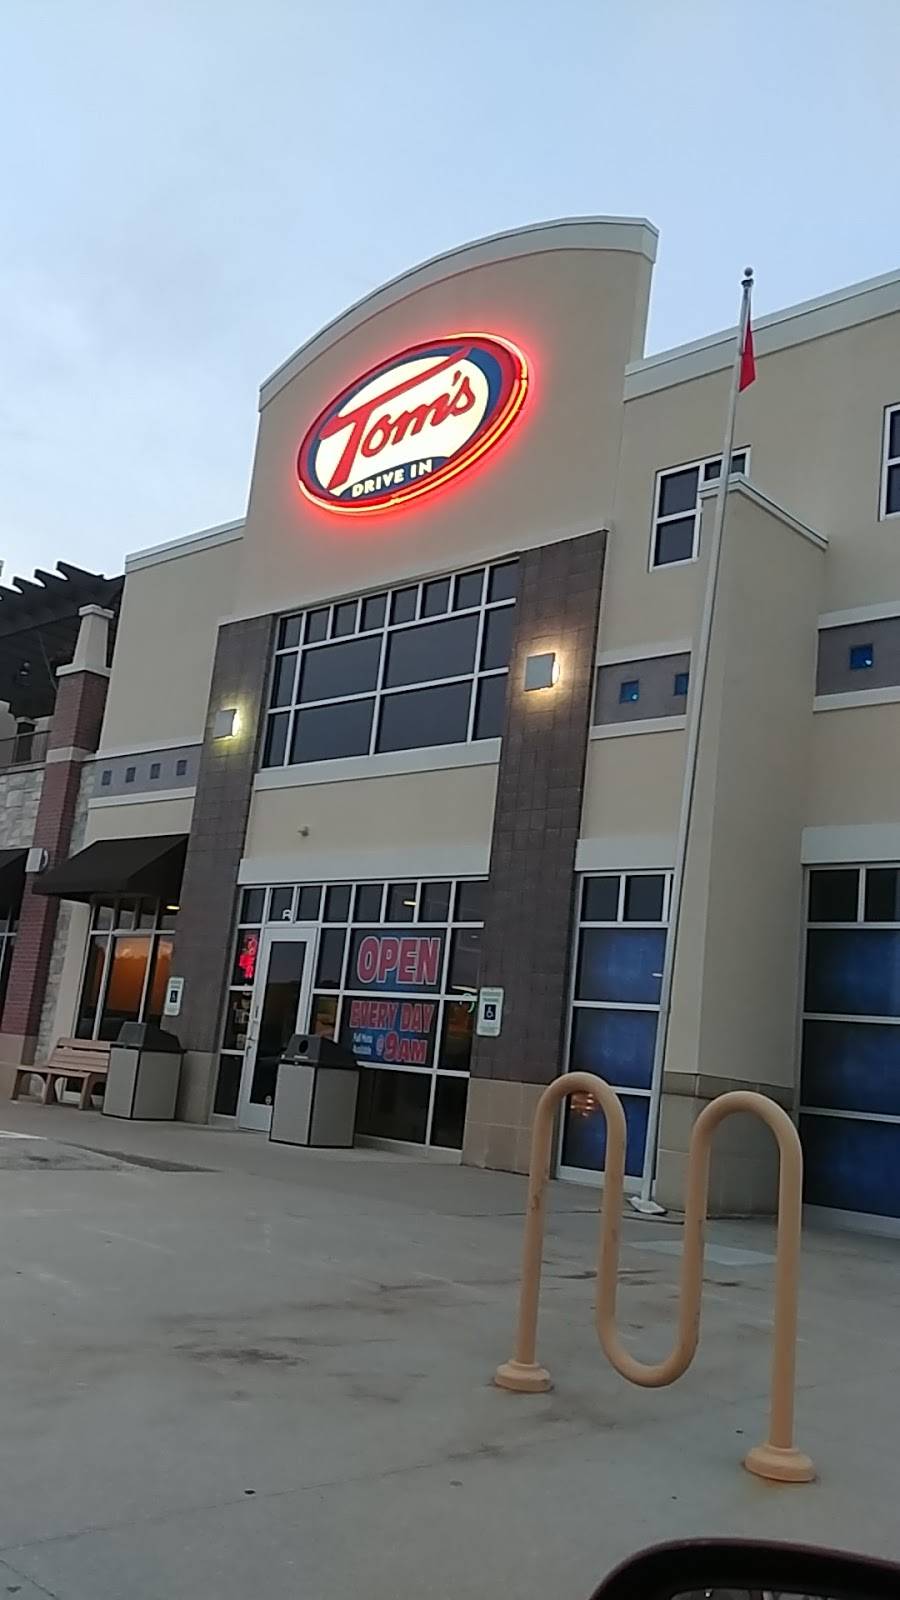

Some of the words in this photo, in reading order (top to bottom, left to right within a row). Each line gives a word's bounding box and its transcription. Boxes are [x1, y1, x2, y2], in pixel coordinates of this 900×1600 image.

[320, 346, 476, 490] Tom's
[352, 469, 405, 498] DRIVE
[410, 459, 432, 478] IN
[357, 936, 441, 985] OPEN
[349, 1000, 398, 1031] EVERY
[400, 1002, 435, 1033] DAY
